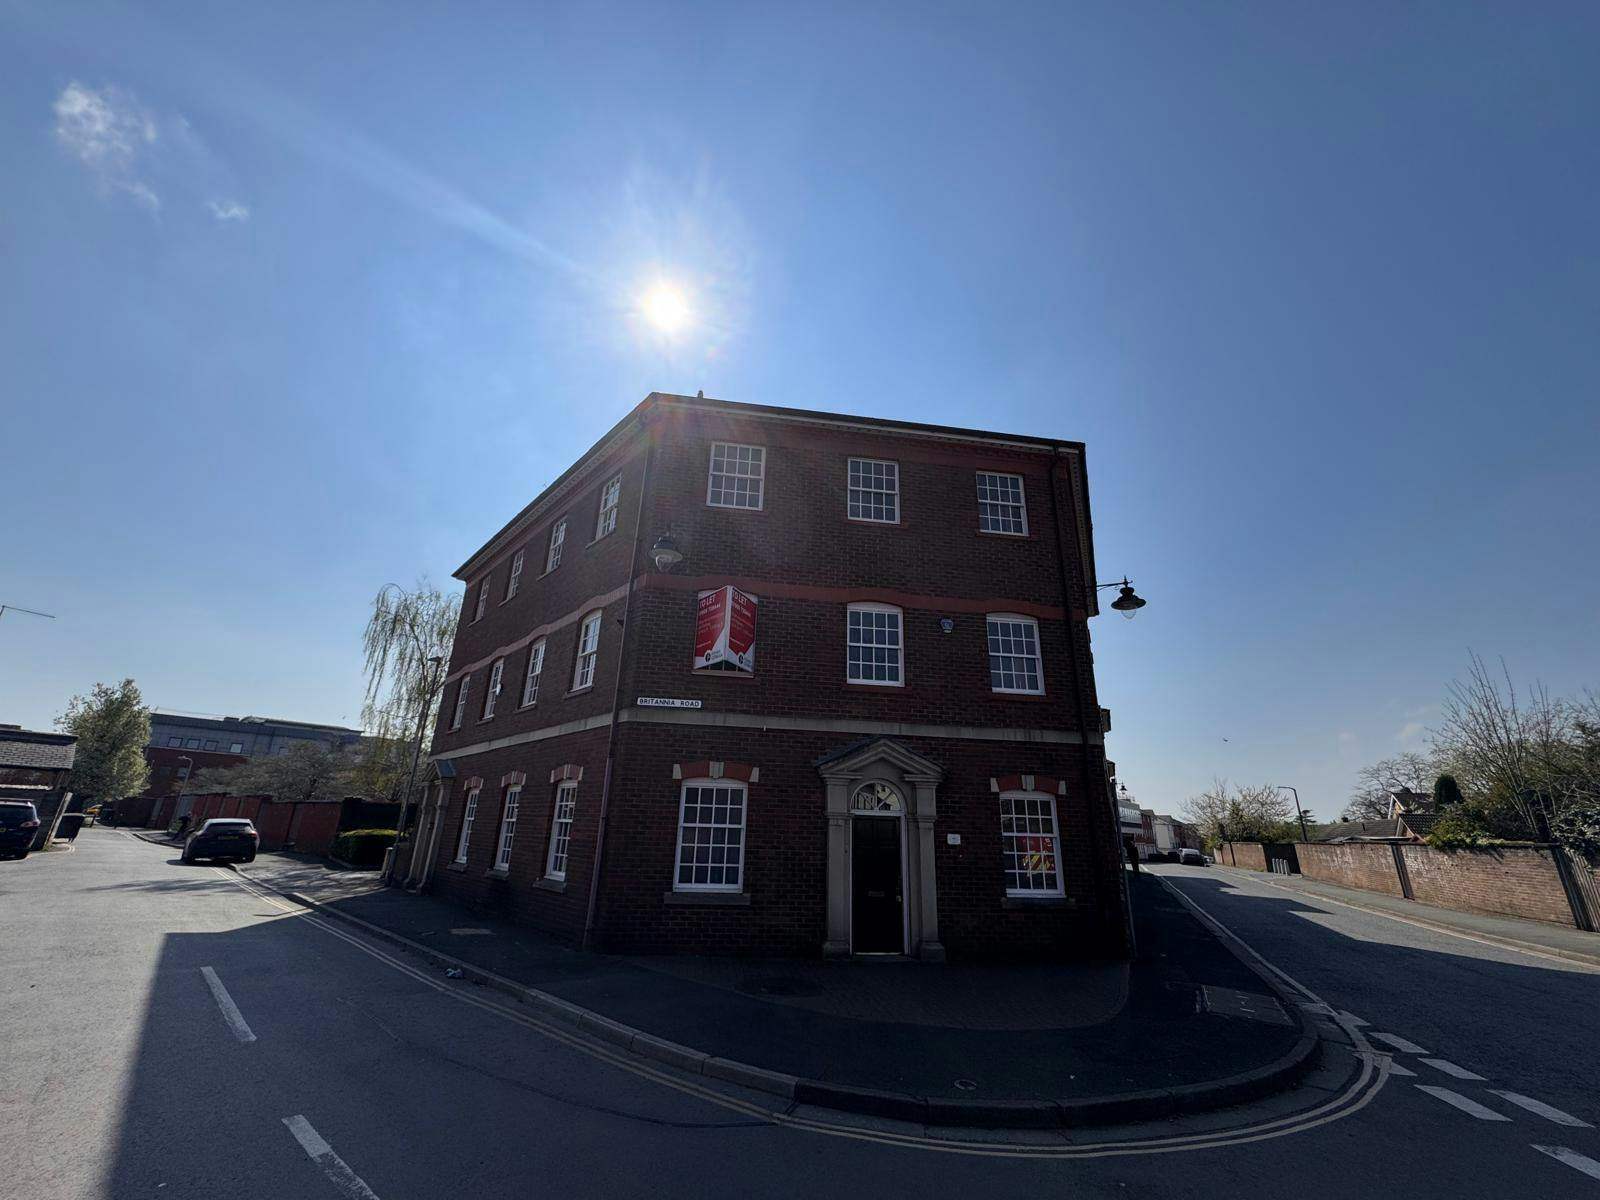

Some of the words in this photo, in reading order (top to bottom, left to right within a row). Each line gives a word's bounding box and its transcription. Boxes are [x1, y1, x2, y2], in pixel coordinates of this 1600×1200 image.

[700, 600, 706, 608] TO
[706, 594, 715, 605] LET
[739, 595, 748, 605] LET
[639, 698, 675, 706] BRITANNIA
